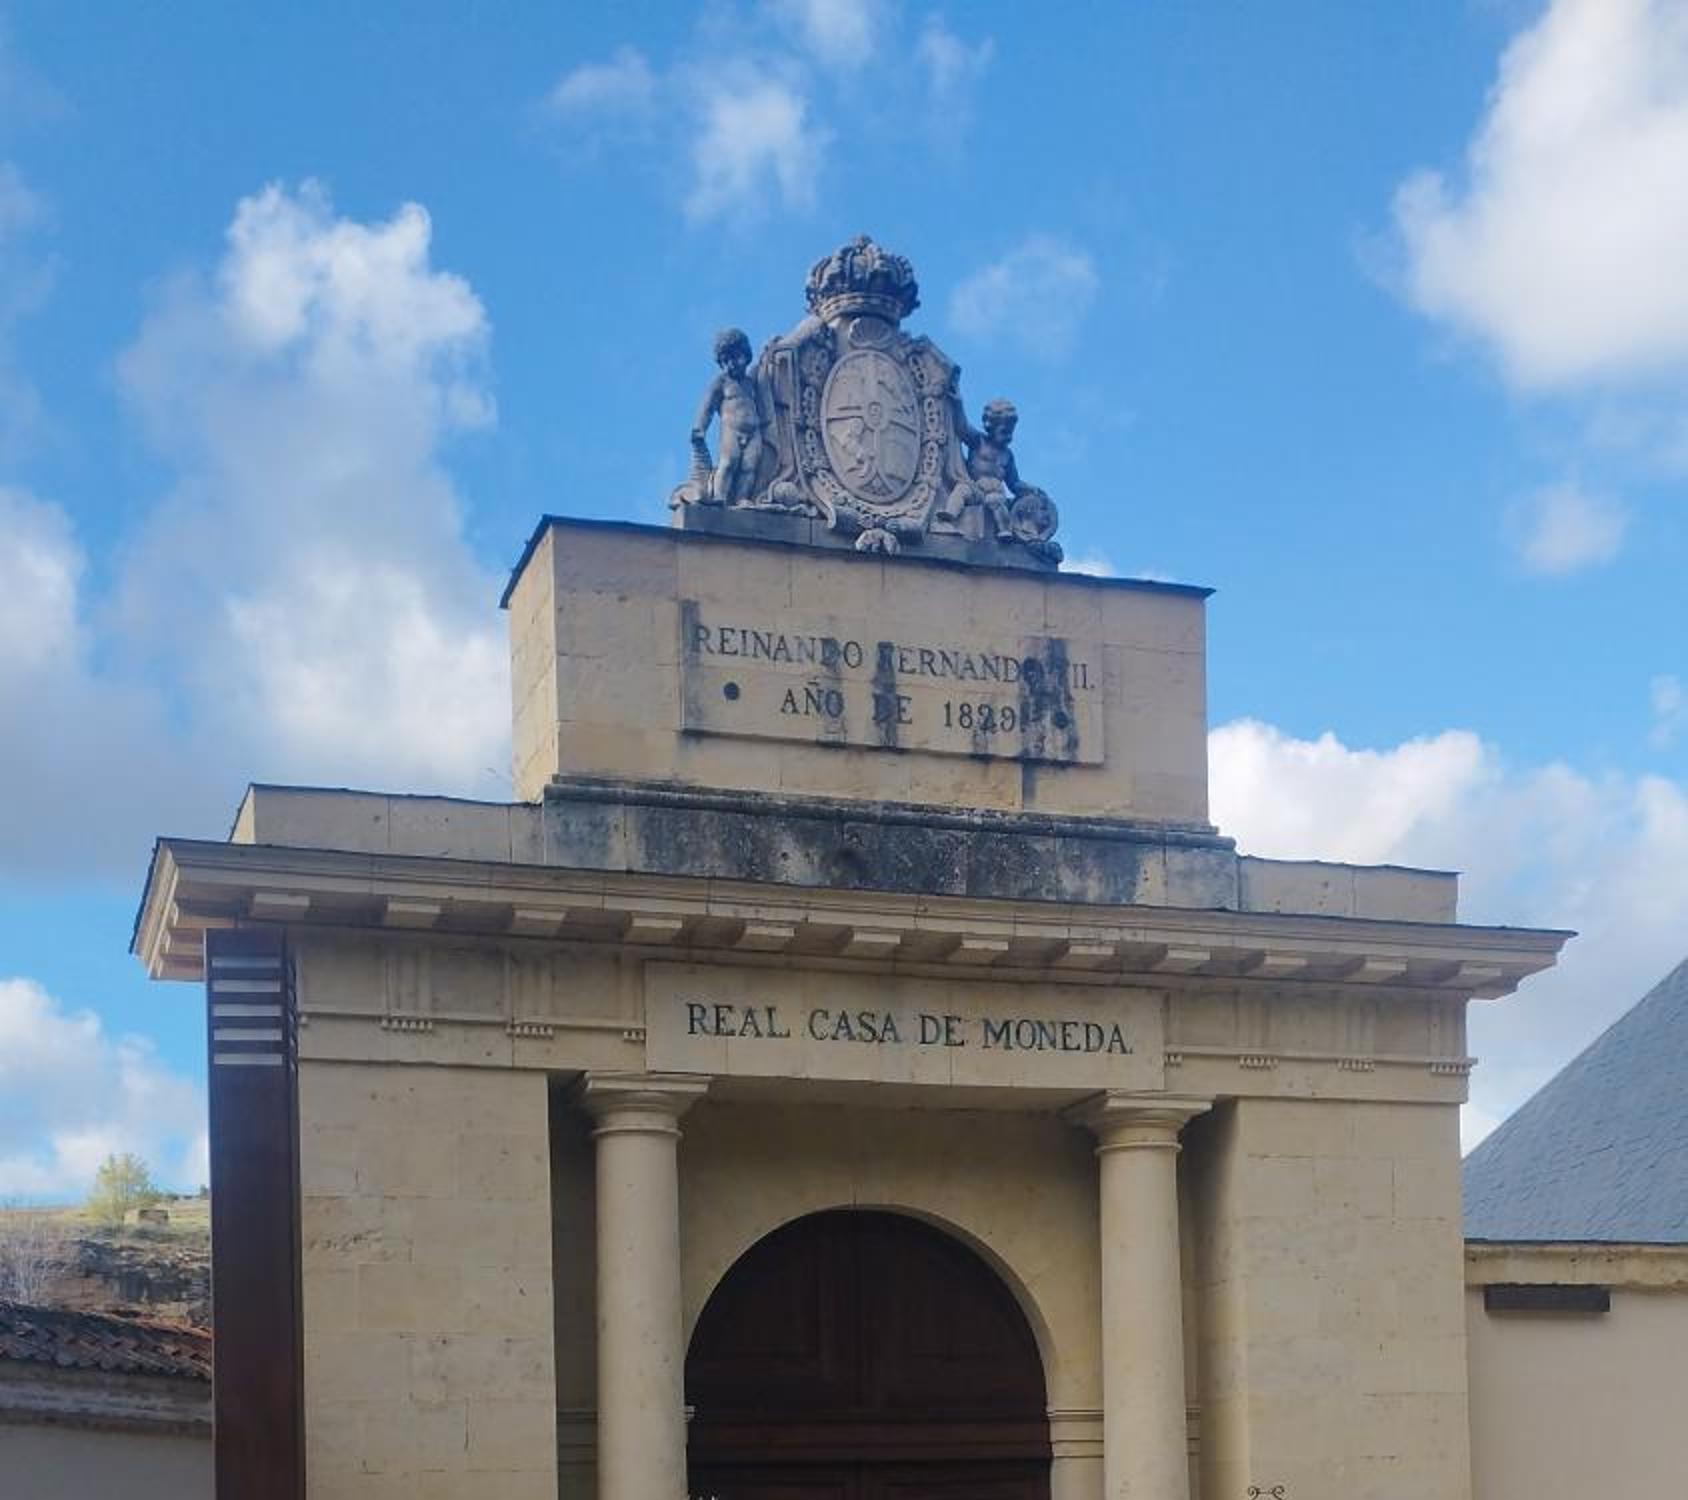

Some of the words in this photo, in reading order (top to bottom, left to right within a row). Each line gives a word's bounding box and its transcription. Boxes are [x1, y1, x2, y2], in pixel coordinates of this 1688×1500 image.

[693, 624, 863, 668] REINANDO
[780, 676, 844, 718] AÑO
[872, 694, 913, 725] DE
[685, 1002, 791, 1038] REAL
[808, 1009, 902, 1043] CASA
[918, 1014, 965, 1047] DE
[982, 1018, 1133, 1055] MONEDA.
